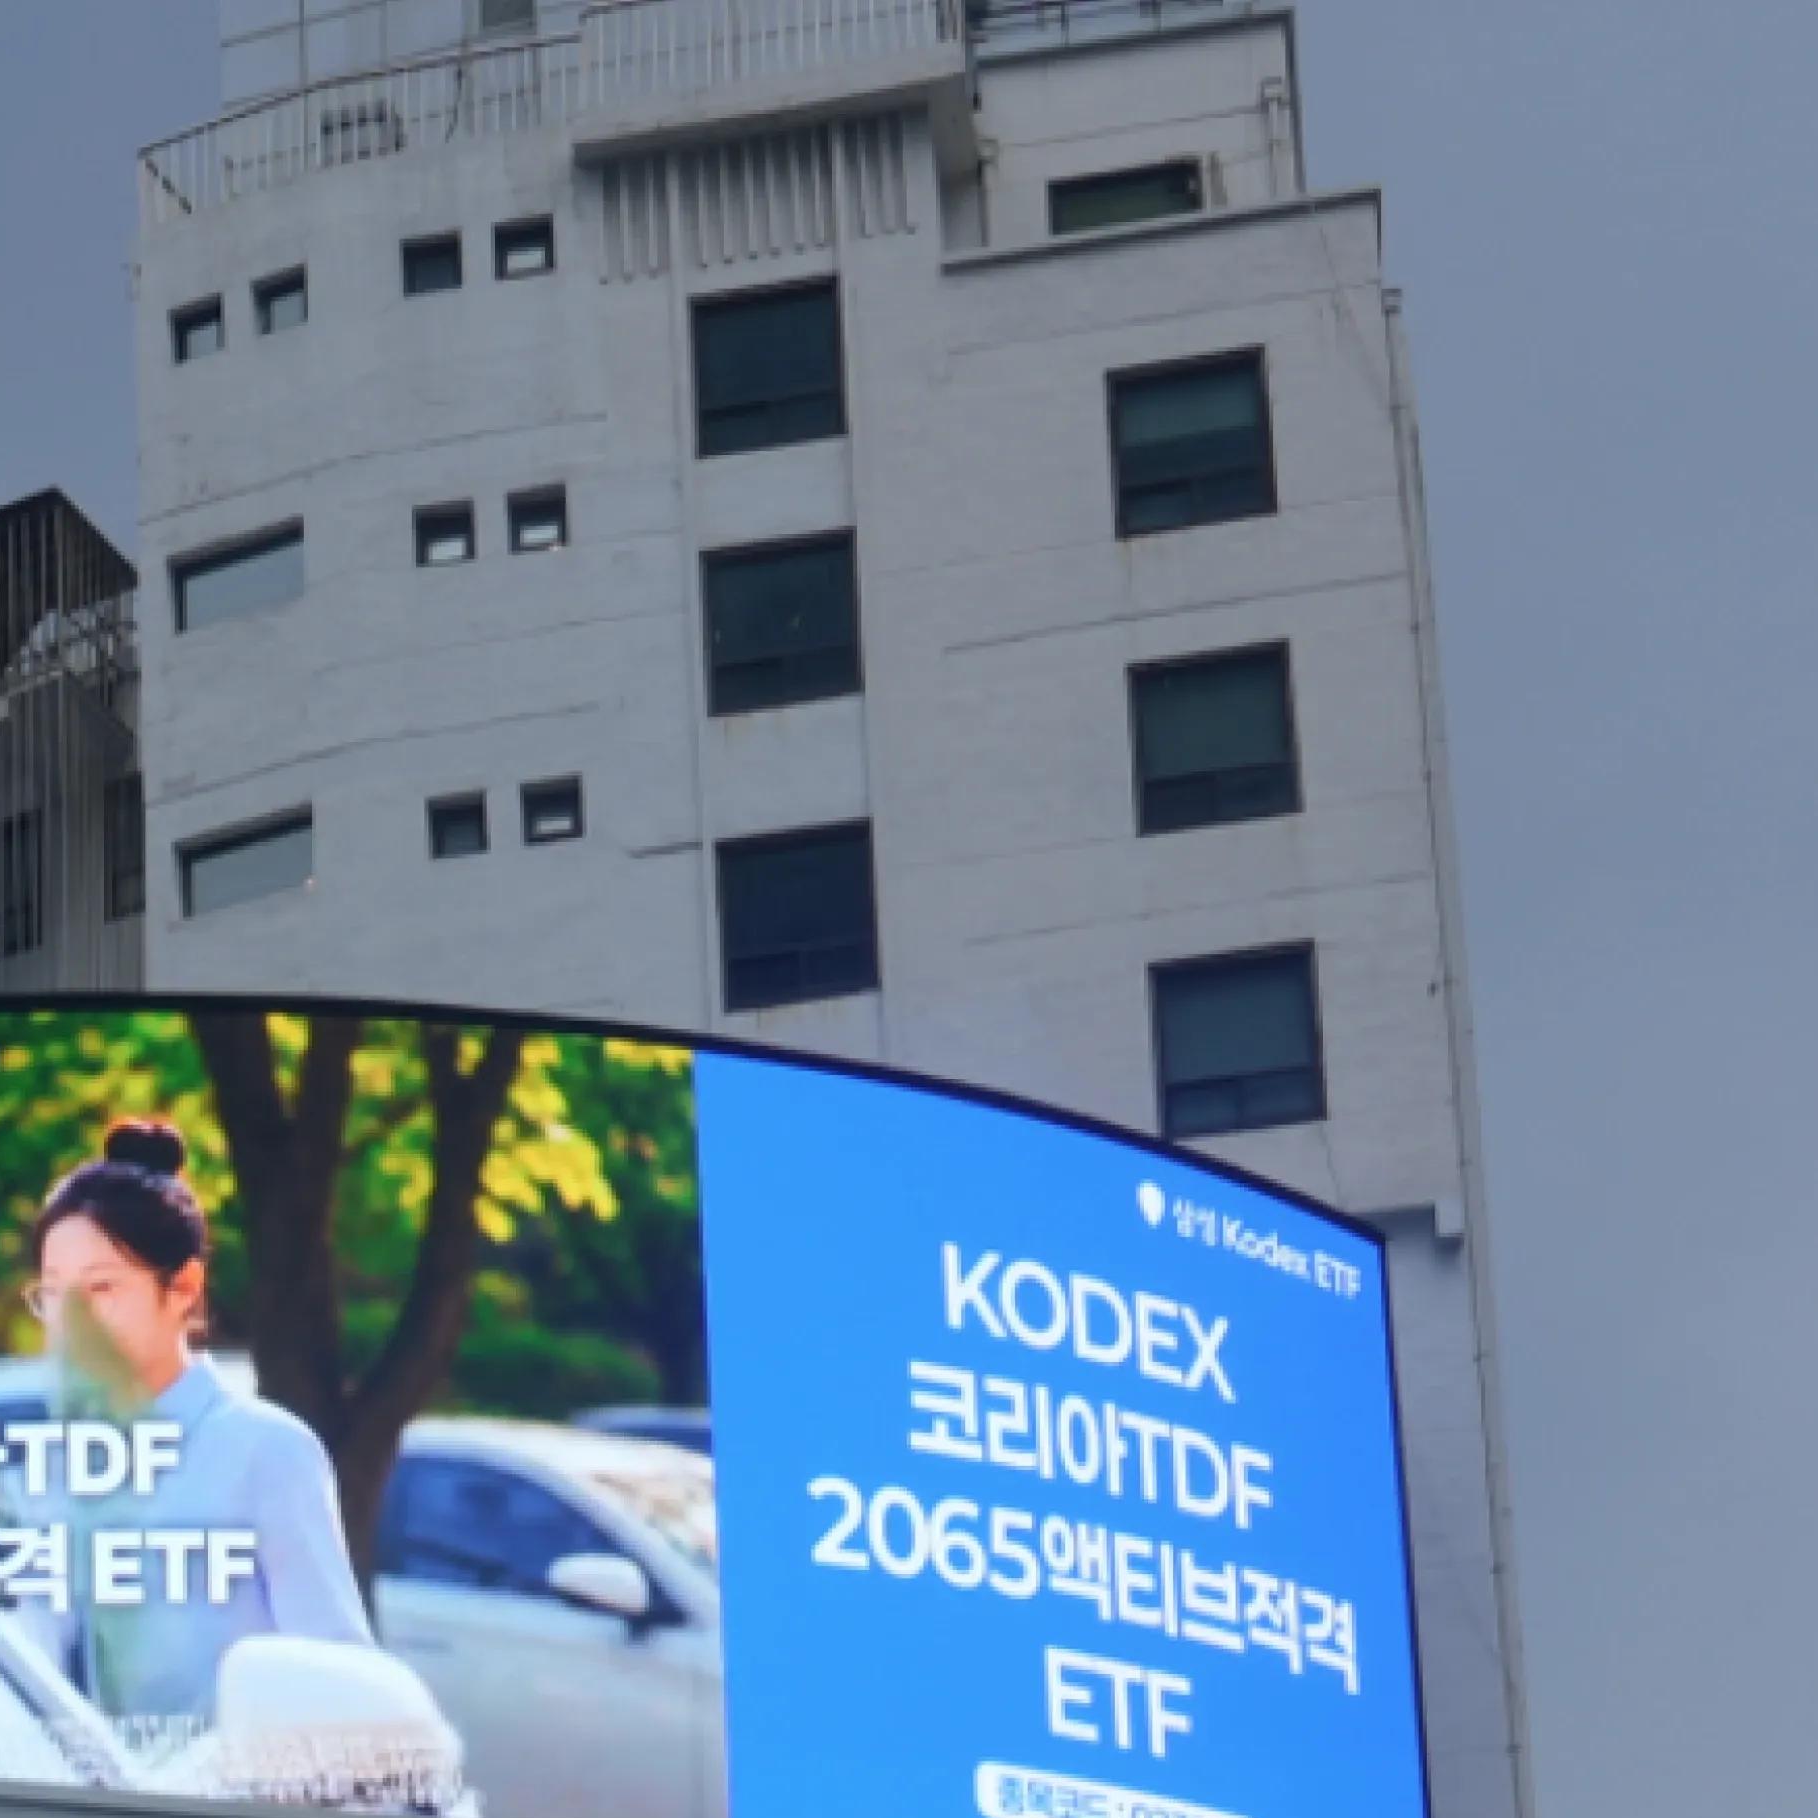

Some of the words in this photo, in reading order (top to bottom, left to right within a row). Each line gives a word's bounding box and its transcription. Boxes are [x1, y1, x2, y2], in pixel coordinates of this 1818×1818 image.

[942, 1242, 1236, 1403] KODEX
[1222, 1215, 1310, 1279] Kodex
[1314, 1250, 1361, 1299] ETF
[908, 1359, 1273, 1530] 코리아TDF
[92, 1527, 257, 1605] ETF
[806, 1475, 1360, 1696] 2065액티브적격
[1044, 1645, 1192, 1758] ETF
